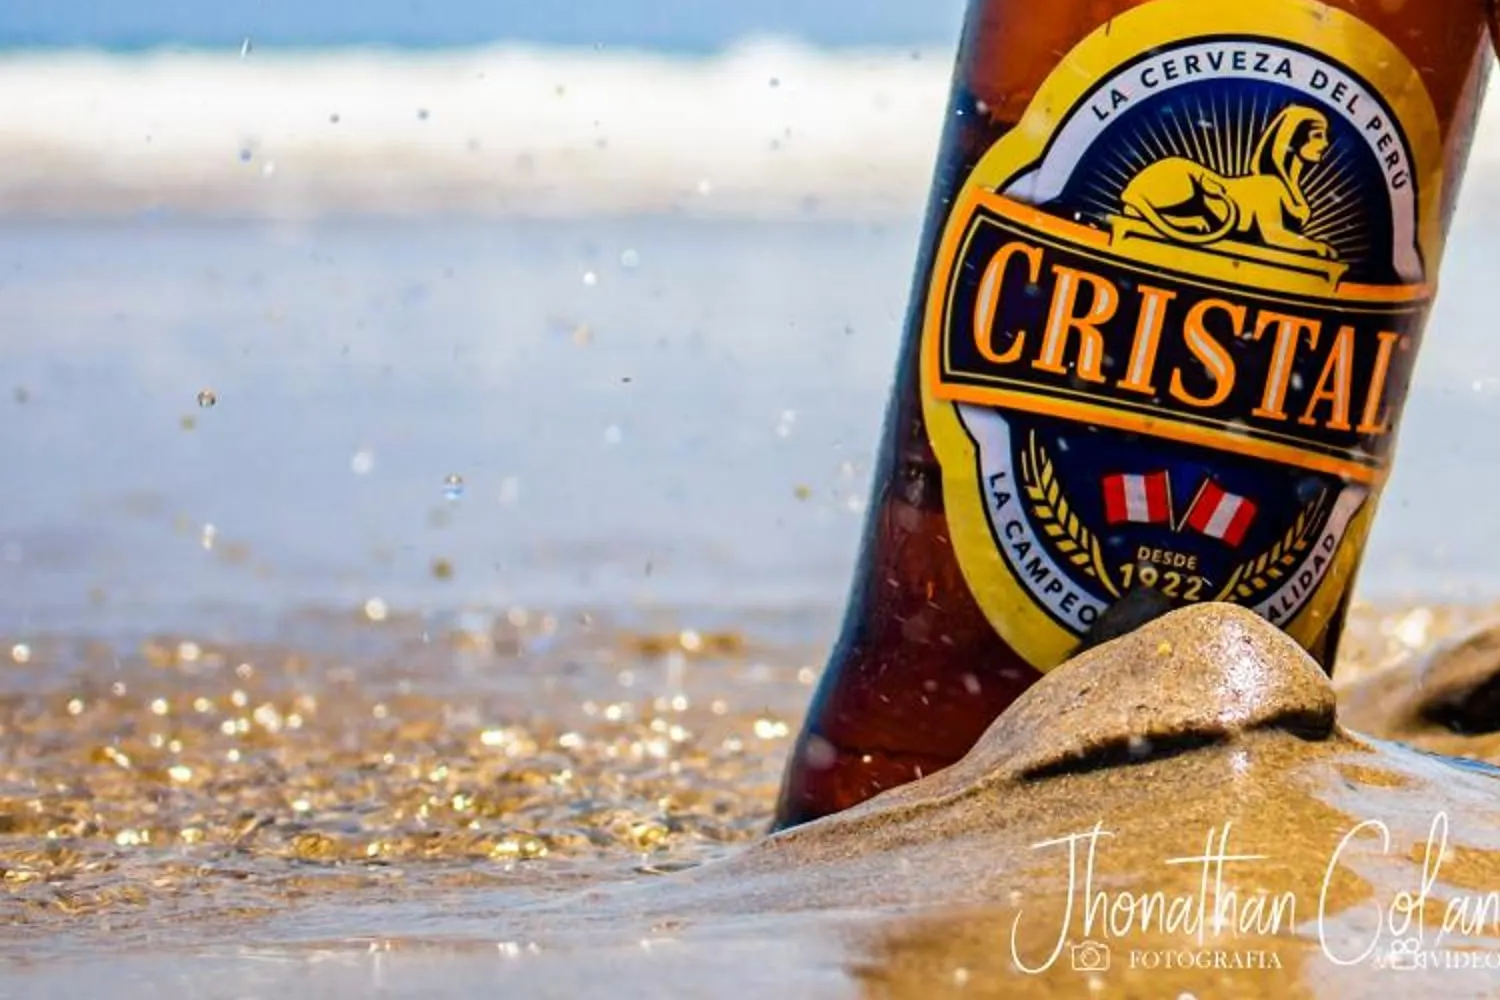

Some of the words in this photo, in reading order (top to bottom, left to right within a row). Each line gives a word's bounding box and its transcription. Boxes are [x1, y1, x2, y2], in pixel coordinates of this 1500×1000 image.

[1092, 91, 1130, 122] LA
[1140, 50, 1294, 88] CERVEZA
[1312, 69, 1358, 116] DEL
[1366, 118, 1408, 192] PERÚ
[972, 241, 1396, 436] CRISTAL
[988, 471, 1009, 504] LA
[1005, 518, 1098, 626] CAMPEO
[1264, 532, 1336, 622] ALIDAD
[1137, 545, 1198, 571] DESDE
